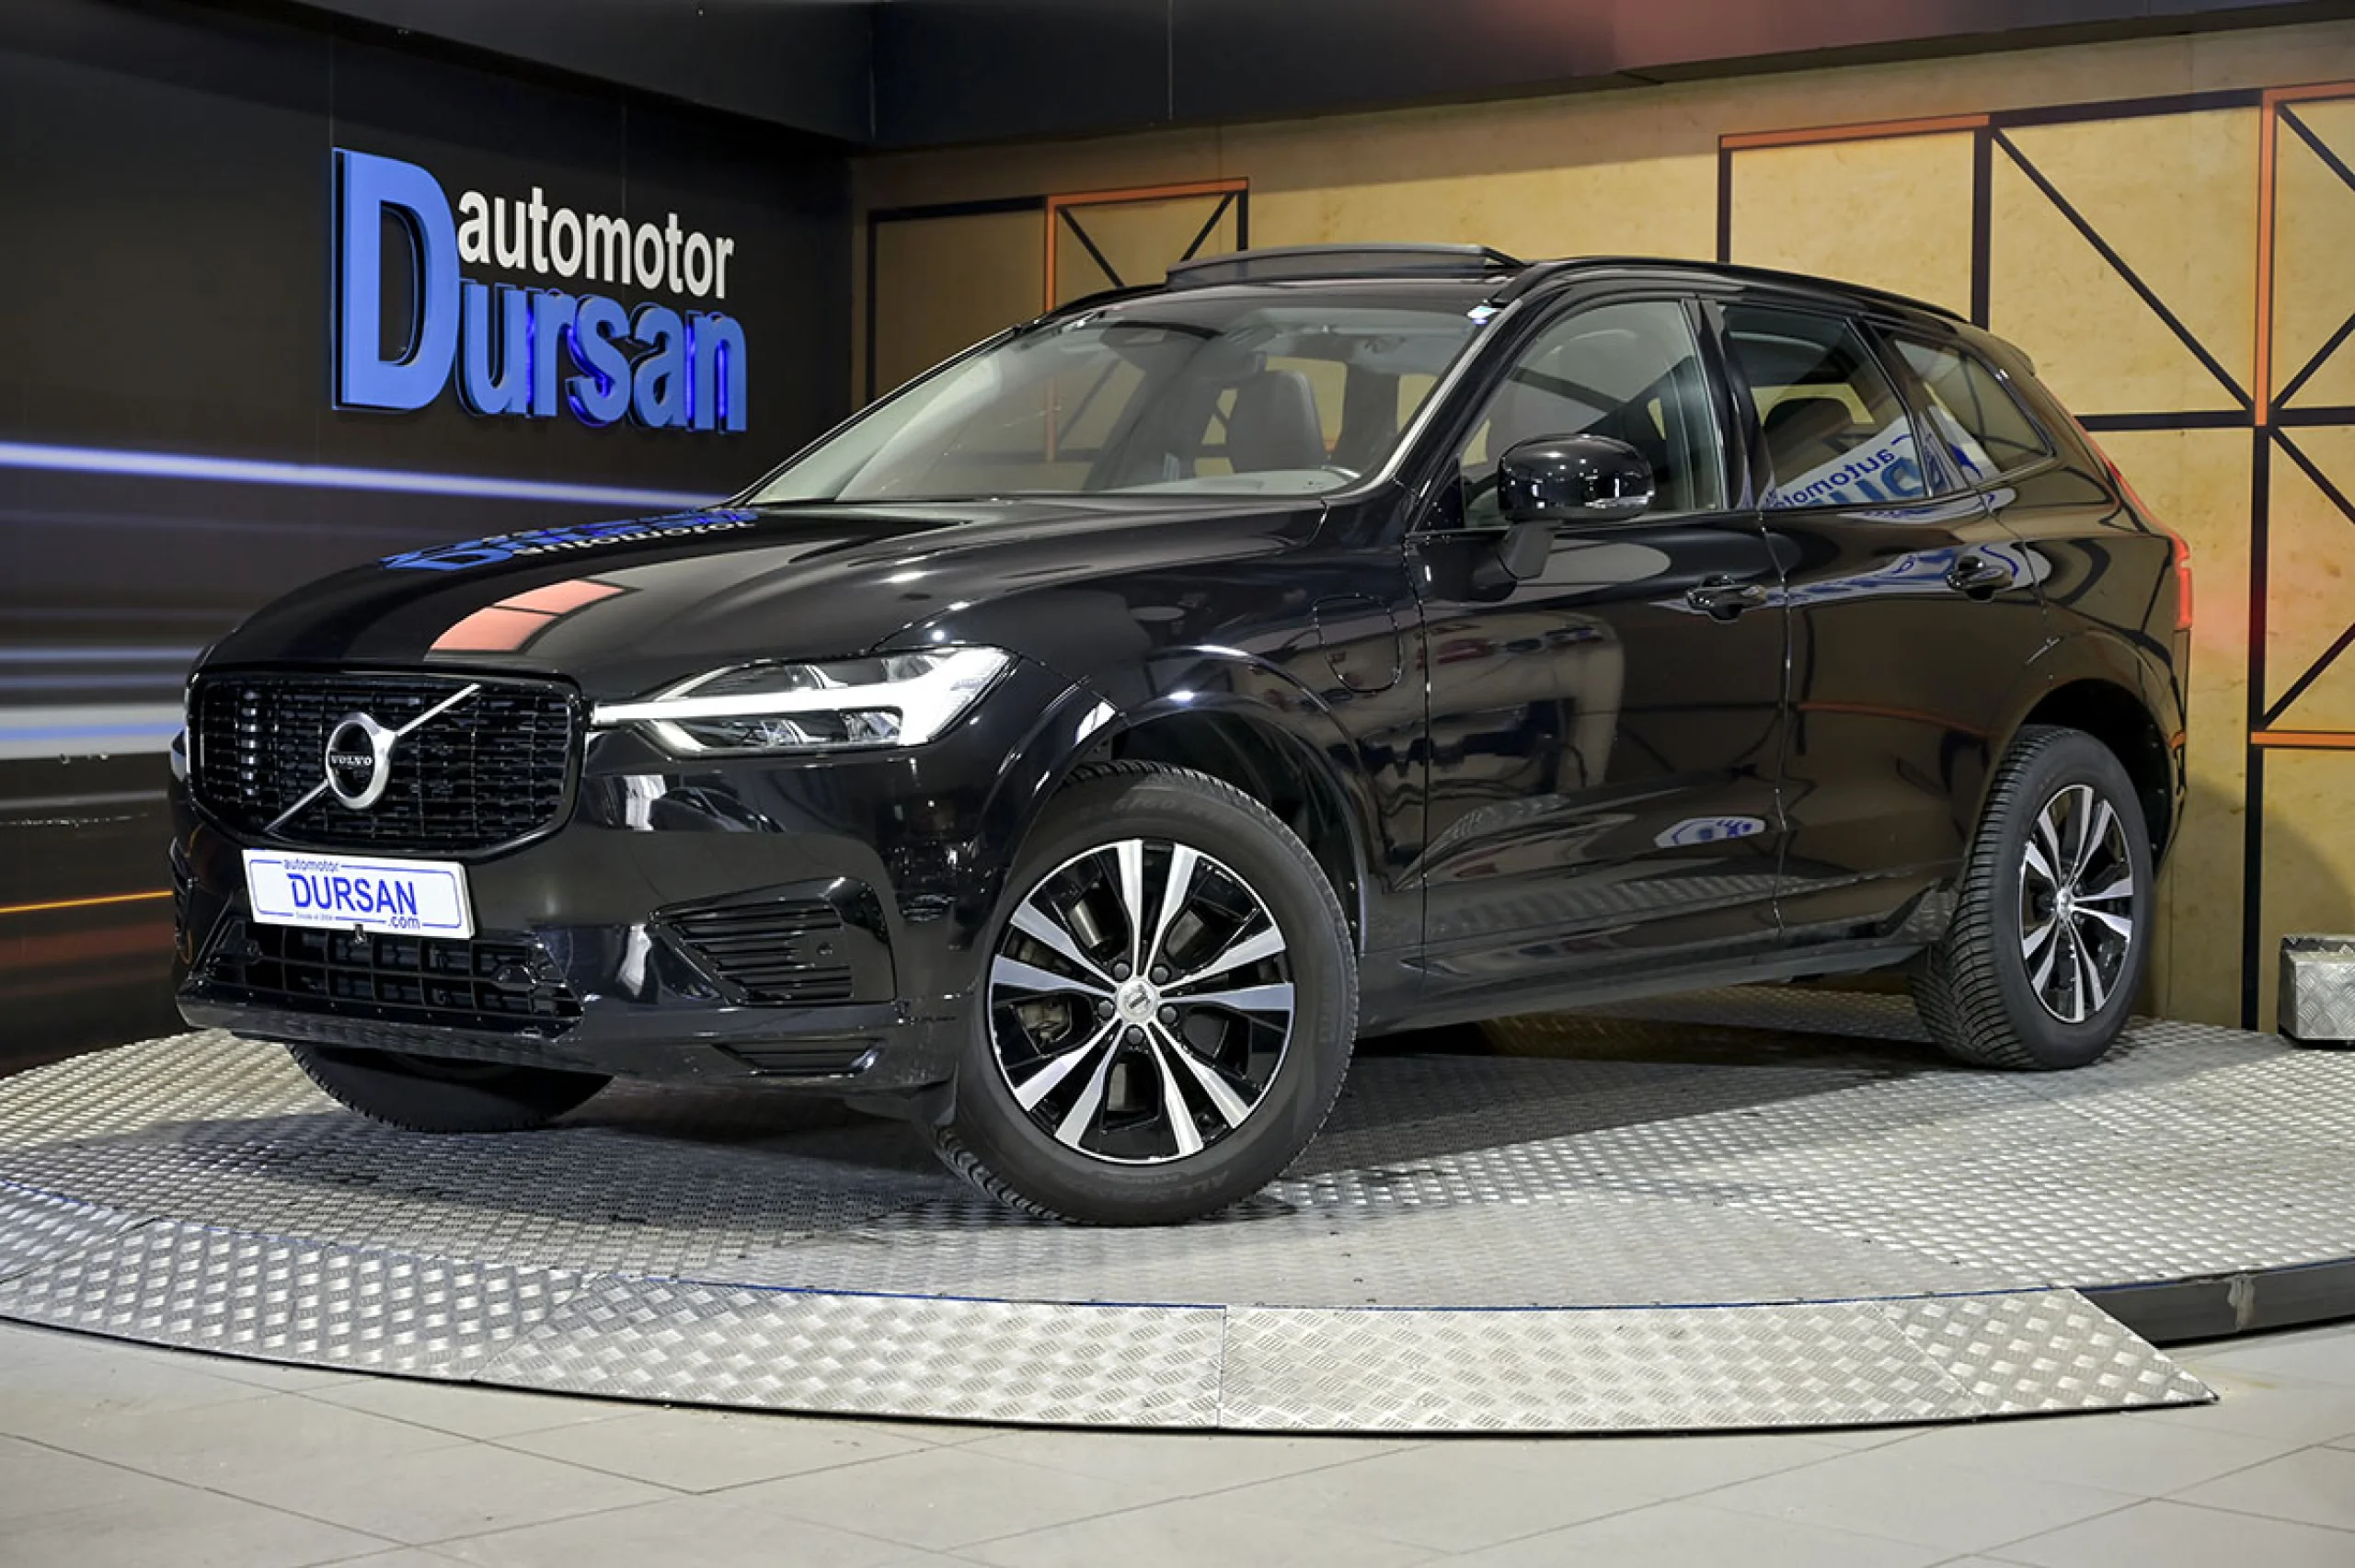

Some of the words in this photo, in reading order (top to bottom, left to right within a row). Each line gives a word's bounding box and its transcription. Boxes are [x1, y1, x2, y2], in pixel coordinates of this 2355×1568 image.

[458, 187, 734, 298] automotor
[332, 147, 746, 433] Dursan
[331, 755, 373, 766] VOLVO
[283, 858, 340, 872] automotor
[286, 873, 418, 915] DURSAN
